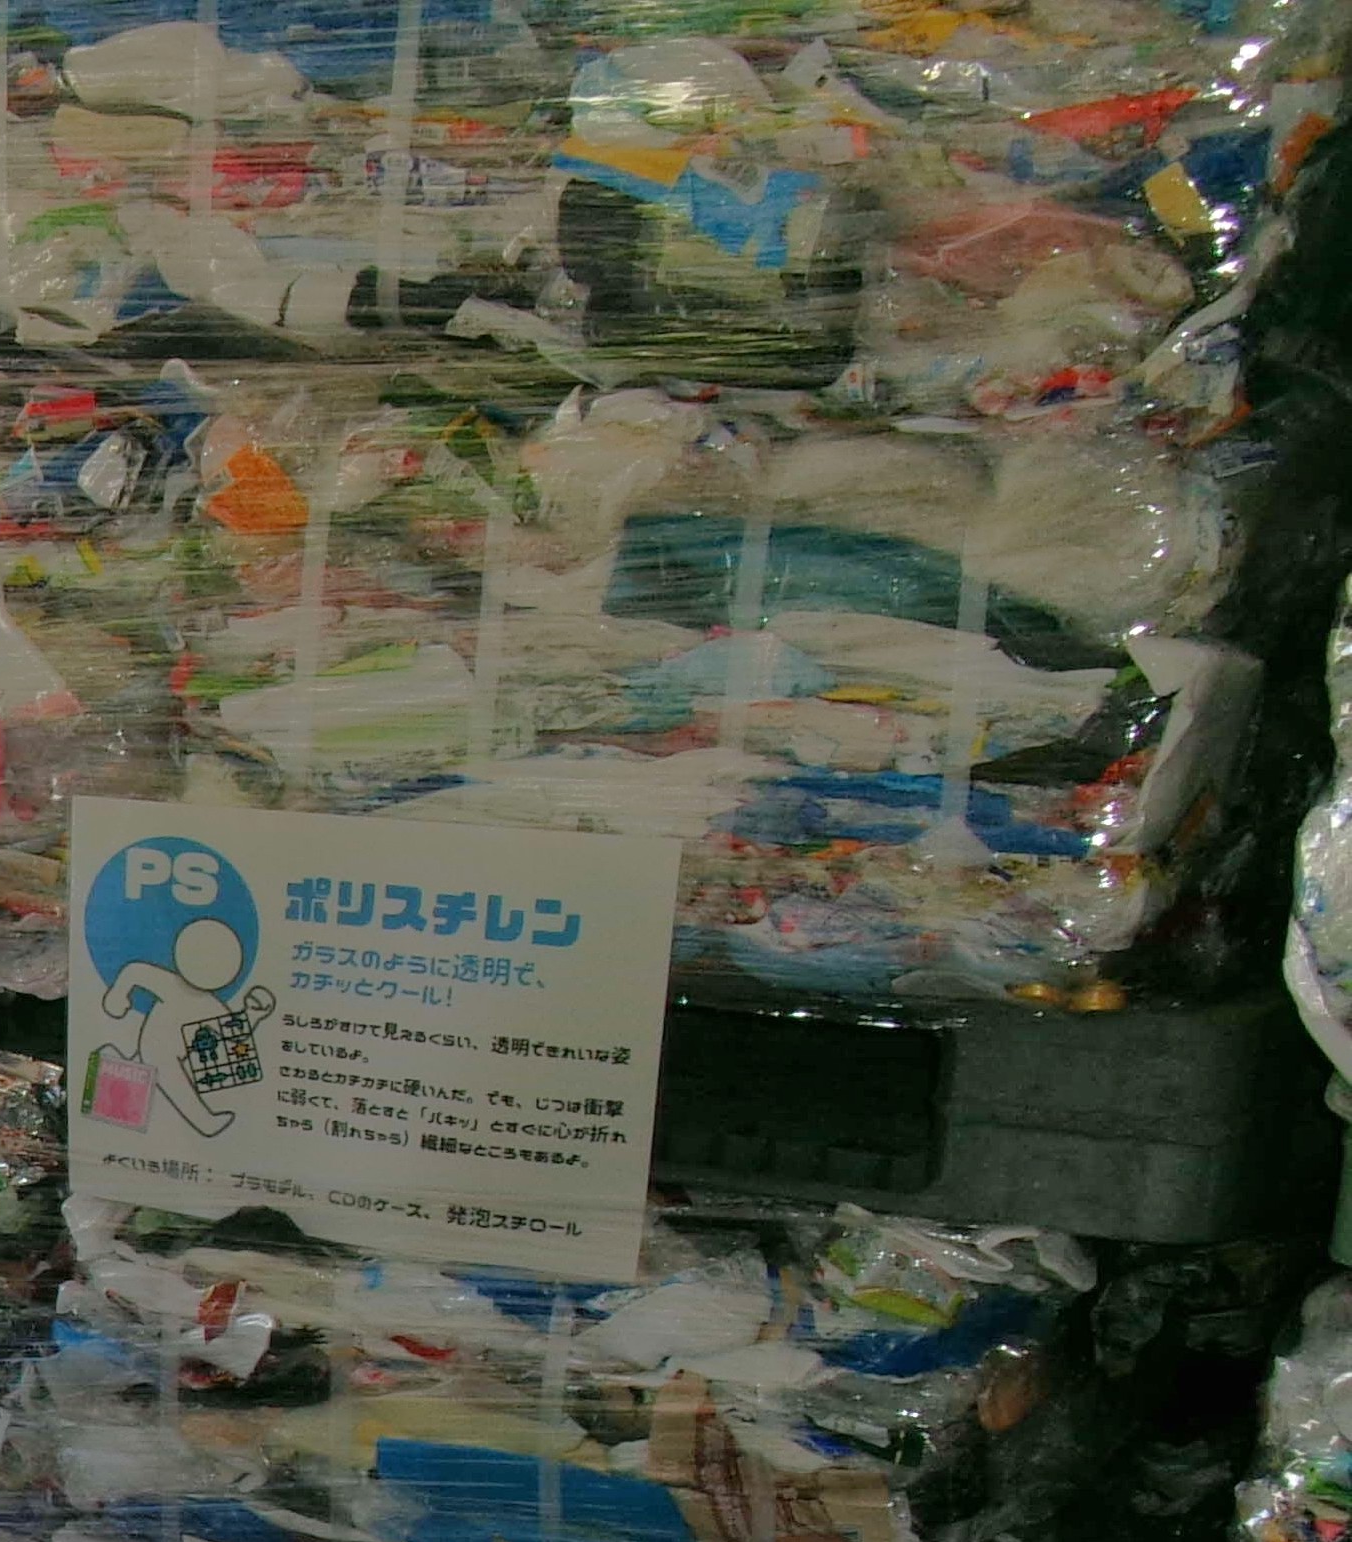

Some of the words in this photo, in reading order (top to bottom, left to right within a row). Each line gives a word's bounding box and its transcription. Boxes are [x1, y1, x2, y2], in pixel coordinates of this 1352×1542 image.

[124, 847, 221, 906] PS
[285, 877, 581, 948] ポリスチレン
[291, 942, 547, 988] ガラスのように透明で、
[289, 969, 453, 1008] カチッとクール！
[281, 1039, 369, 1063] をしているよ。
